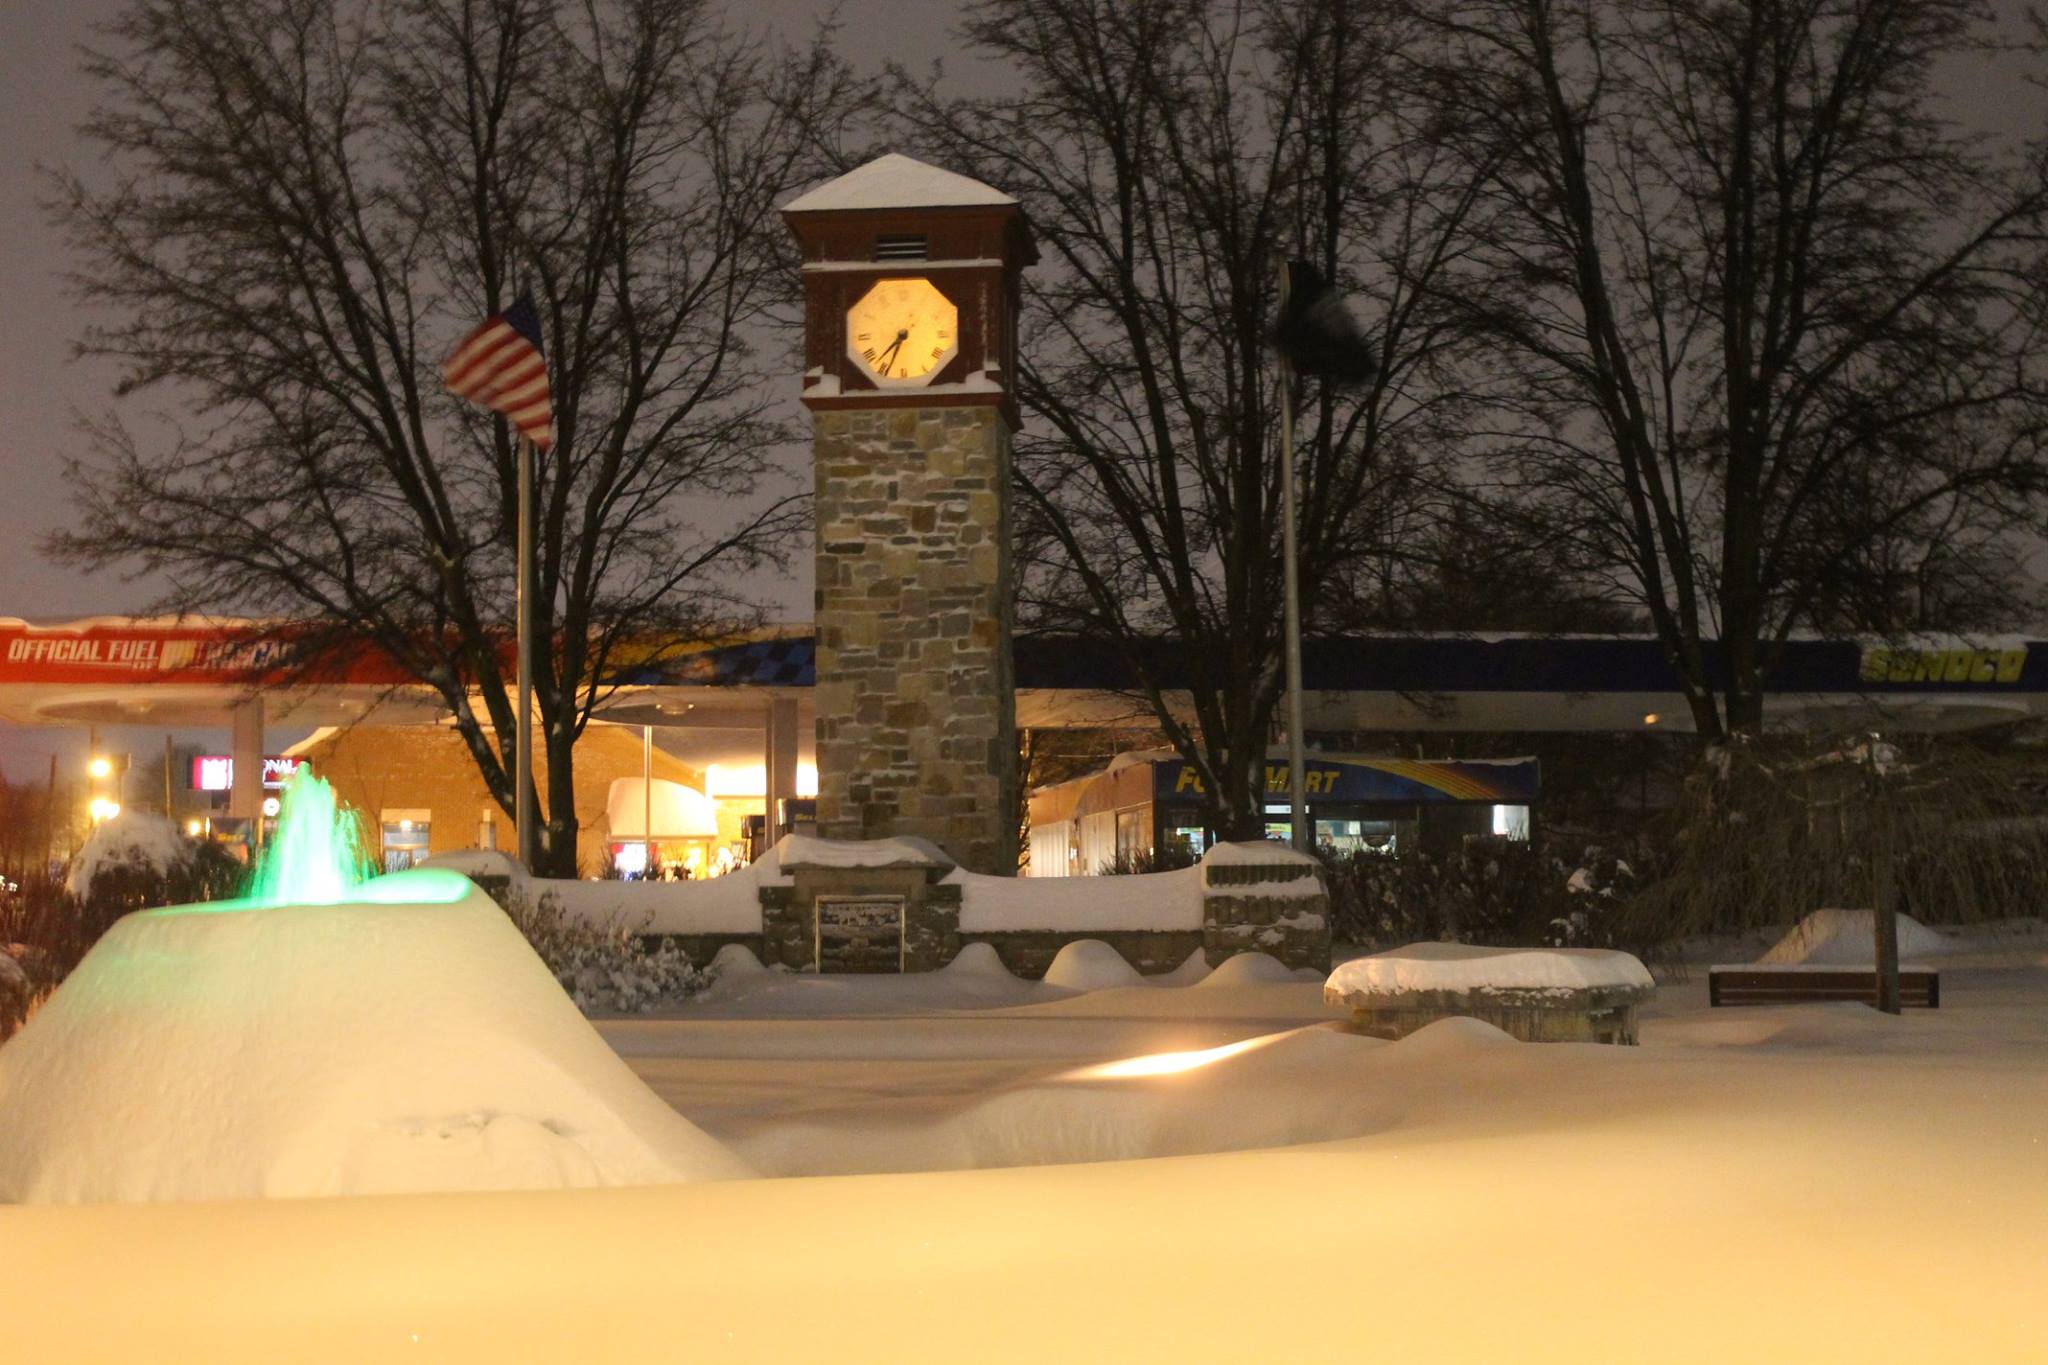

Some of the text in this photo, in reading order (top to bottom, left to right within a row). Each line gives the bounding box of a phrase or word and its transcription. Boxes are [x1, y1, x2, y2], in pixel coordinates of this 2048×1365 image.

[8, 639, 160, 662] OFFICIAL FUEL
[1264, 766, 1341, 793] MRT
